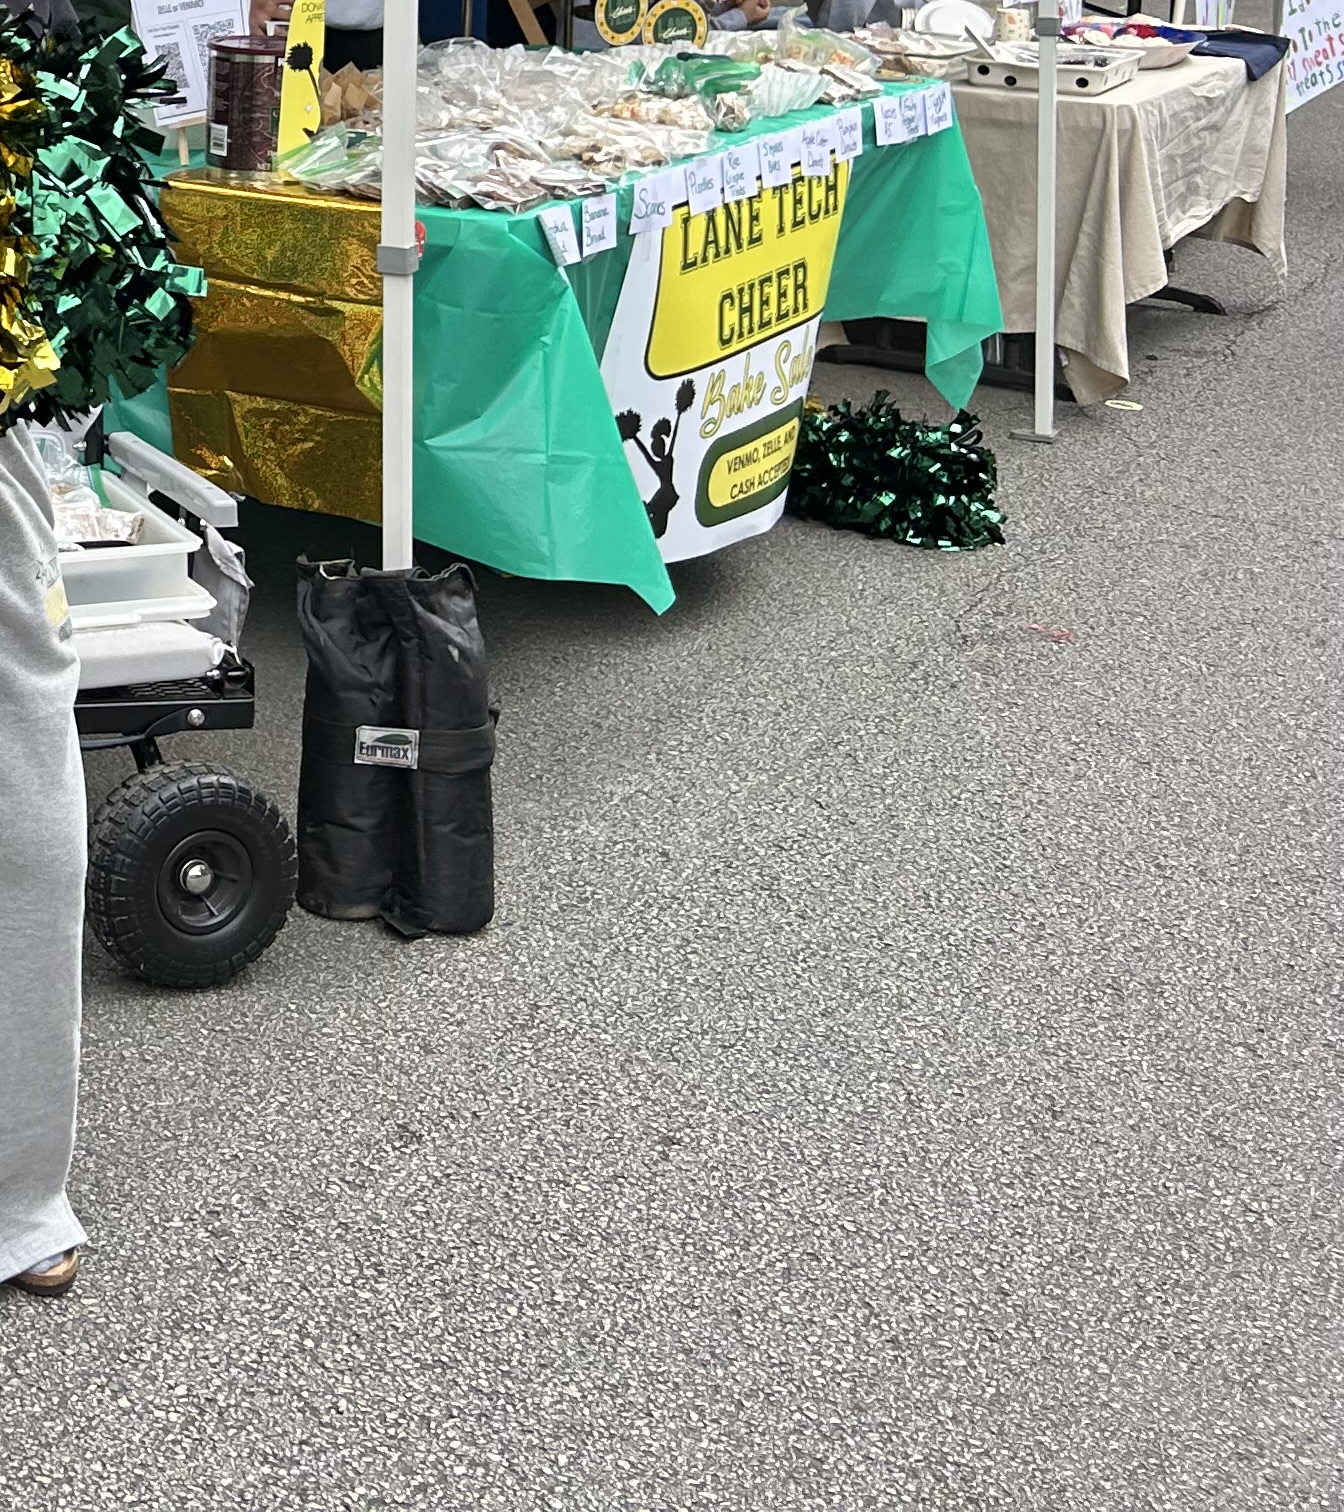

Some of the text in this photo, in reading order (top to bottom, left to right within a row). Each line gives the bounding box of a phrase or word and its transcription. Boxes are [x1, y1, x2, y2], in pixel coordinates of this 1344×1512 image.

[680, 164, 839, 275] LANE TECH
[718, 257, 809, 350] CHEER
[699, 352, 767, 439] Bake
[726, 447, 761, 475] VENMO,
[730, 476, 756, 500] CASH
[359, 740, 410, 761] Eurmax
